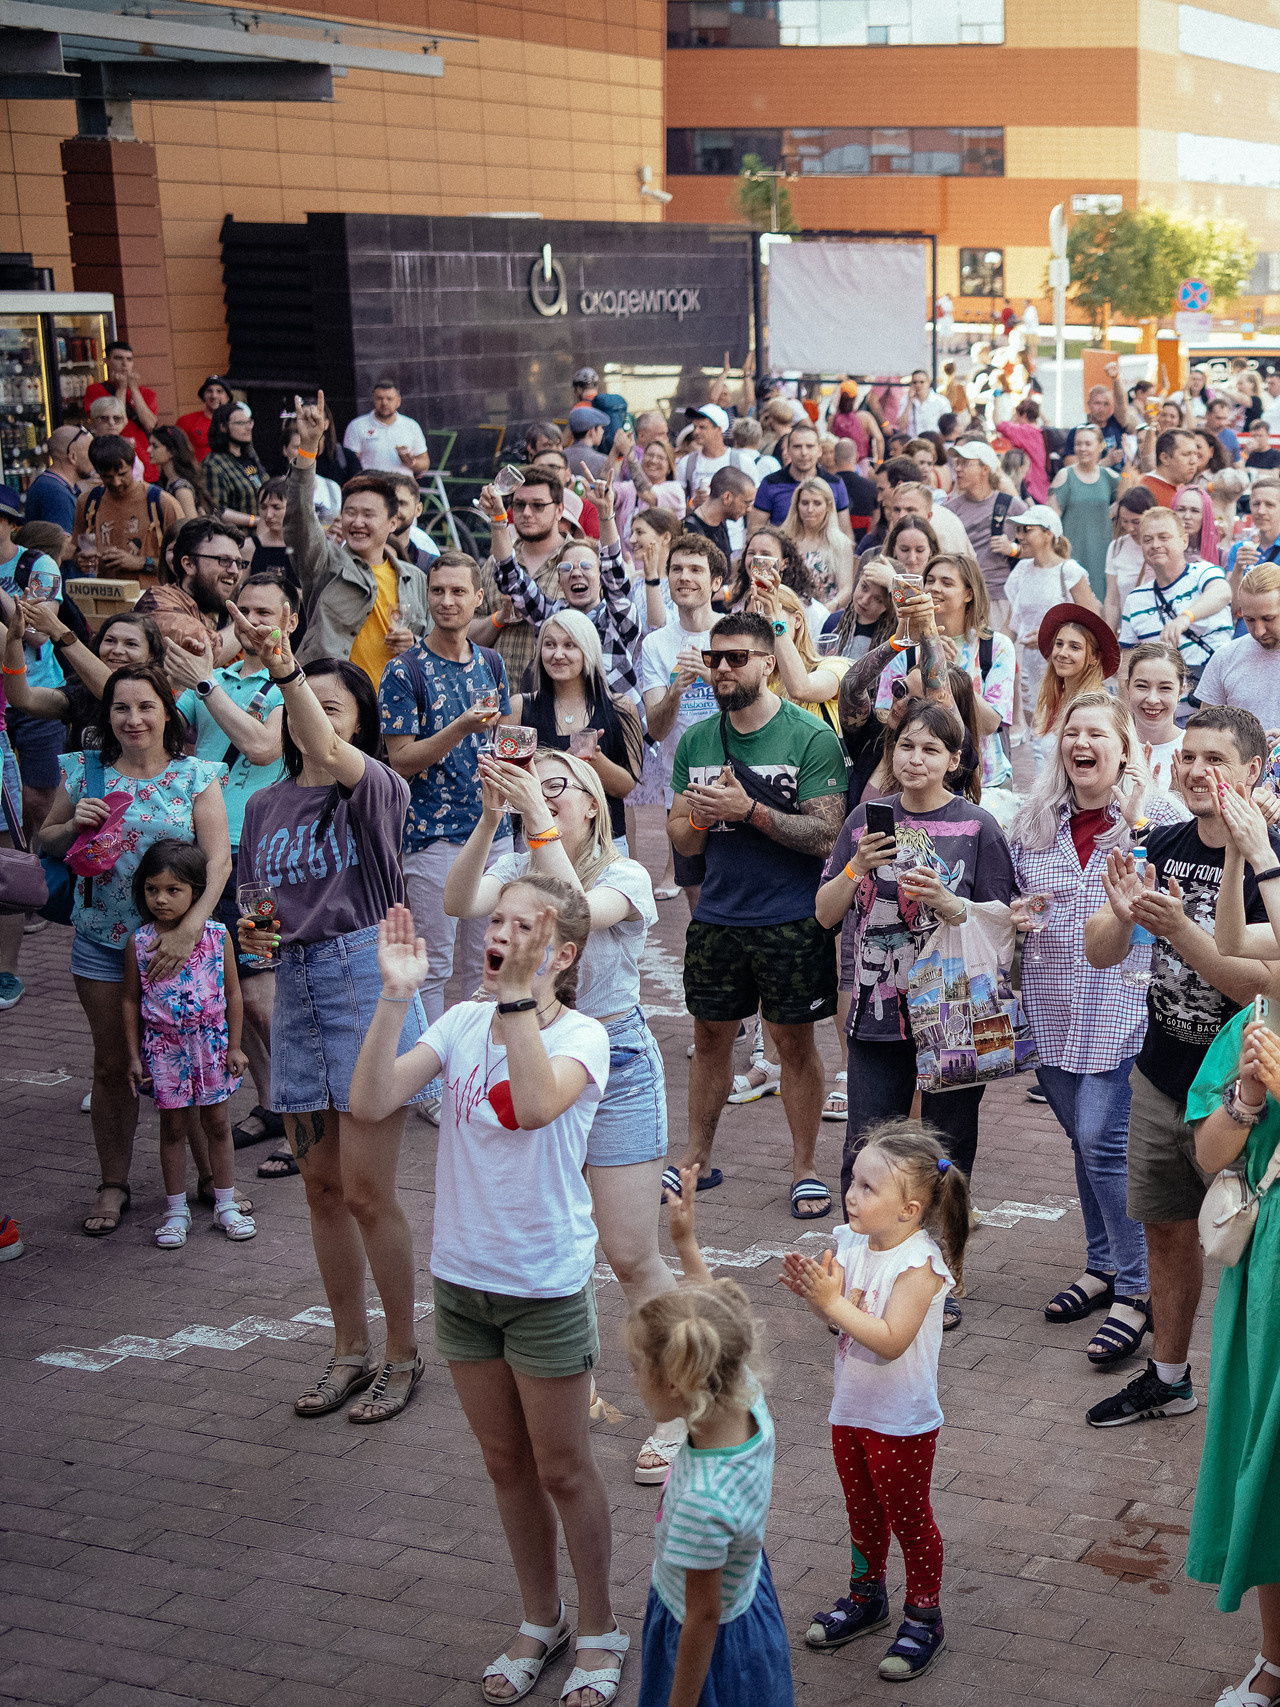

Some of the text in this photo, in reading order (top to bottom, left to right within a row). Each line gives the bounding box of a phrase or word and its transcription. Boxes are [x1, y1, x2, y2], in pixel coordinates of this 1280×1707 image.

[580, 287, 702, 322] академпарк
[68, 584, 121, 597] VERMONT
[1163, 858, 1196, 878] ONLY
[1155, 1012, 1221, 1033] NO GOING BACK
